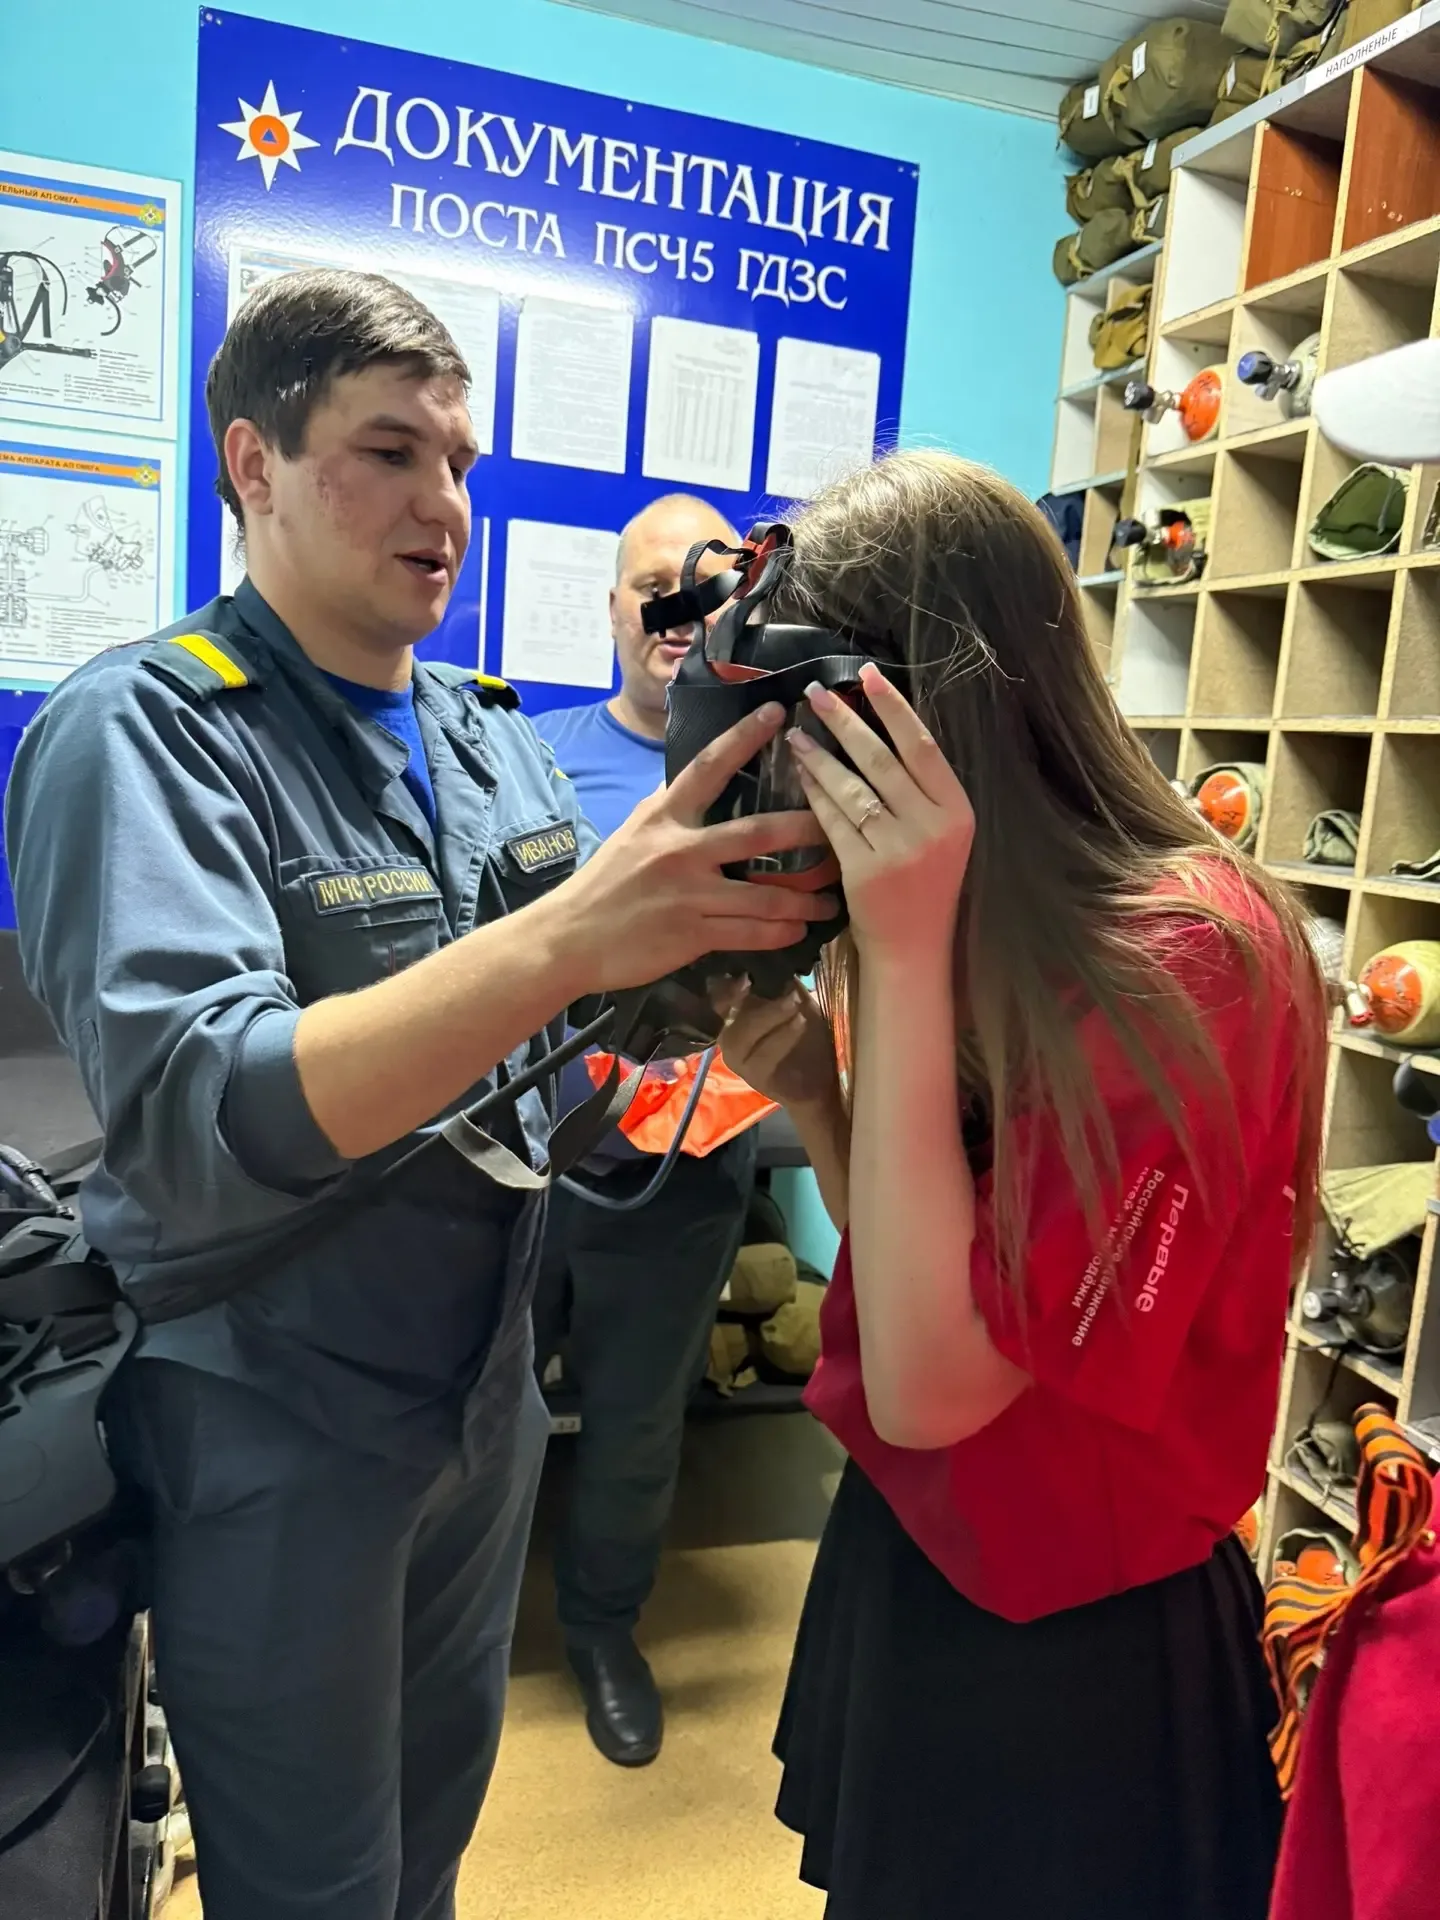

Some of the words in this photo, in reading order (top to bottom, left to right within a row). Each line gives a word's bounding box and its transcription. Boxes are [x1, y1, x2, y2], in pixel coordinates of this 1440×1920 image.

[1325, 27, 1398, 77] НАПОЛНЕНЫЕ
[333, 86, 894, 252] ДОКУМЕНТАЦИЯ
[390, 183, 567, 259] ПОСТА
[595, 221, 715, 284] ПСЧ5
[736, 247, 849, 311] ГДЗС
[318, 876, 364, 907] МЧС
[362, 871, 434, 899] РОССИИ
[516, 829, 576, 866] ИВАНОВ
[1134, 1183, 1190, 1313] Первые
